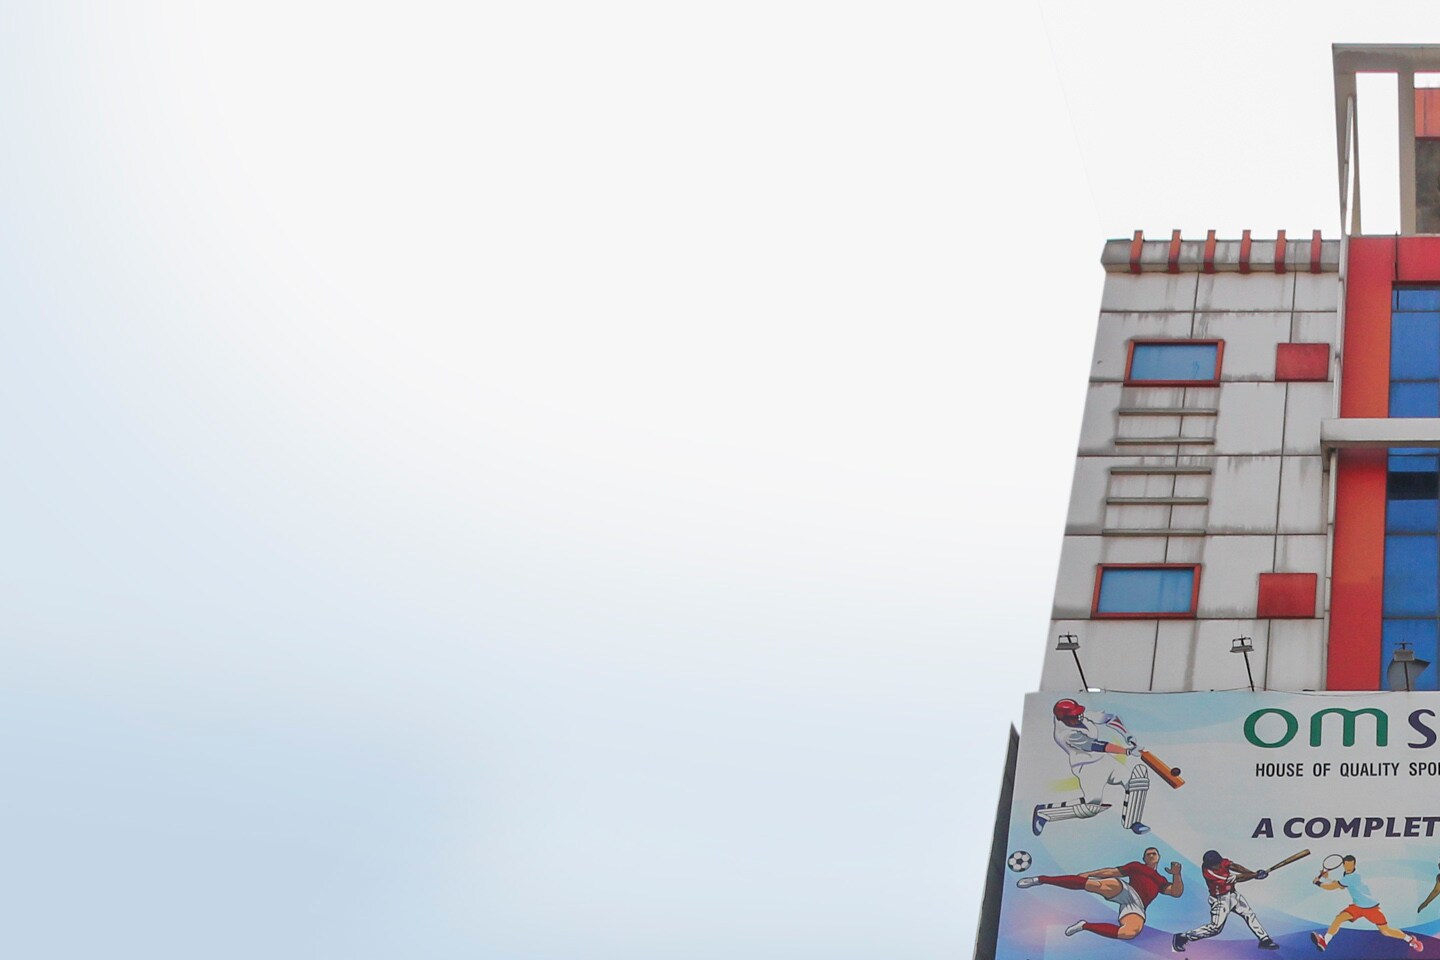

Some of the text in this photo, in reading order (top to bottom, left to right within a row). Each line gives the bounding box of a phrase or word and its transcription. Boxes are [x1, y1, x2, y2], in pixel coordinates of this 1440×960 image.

[1244, 708, 1388, 748] om
[1255, 763, 1304, 777] HOUSE
[1312, 763, 1331, 777] OF
[1340, 762, 1400, 778] QUALITY
[1251, 818, 1275, 838] A
